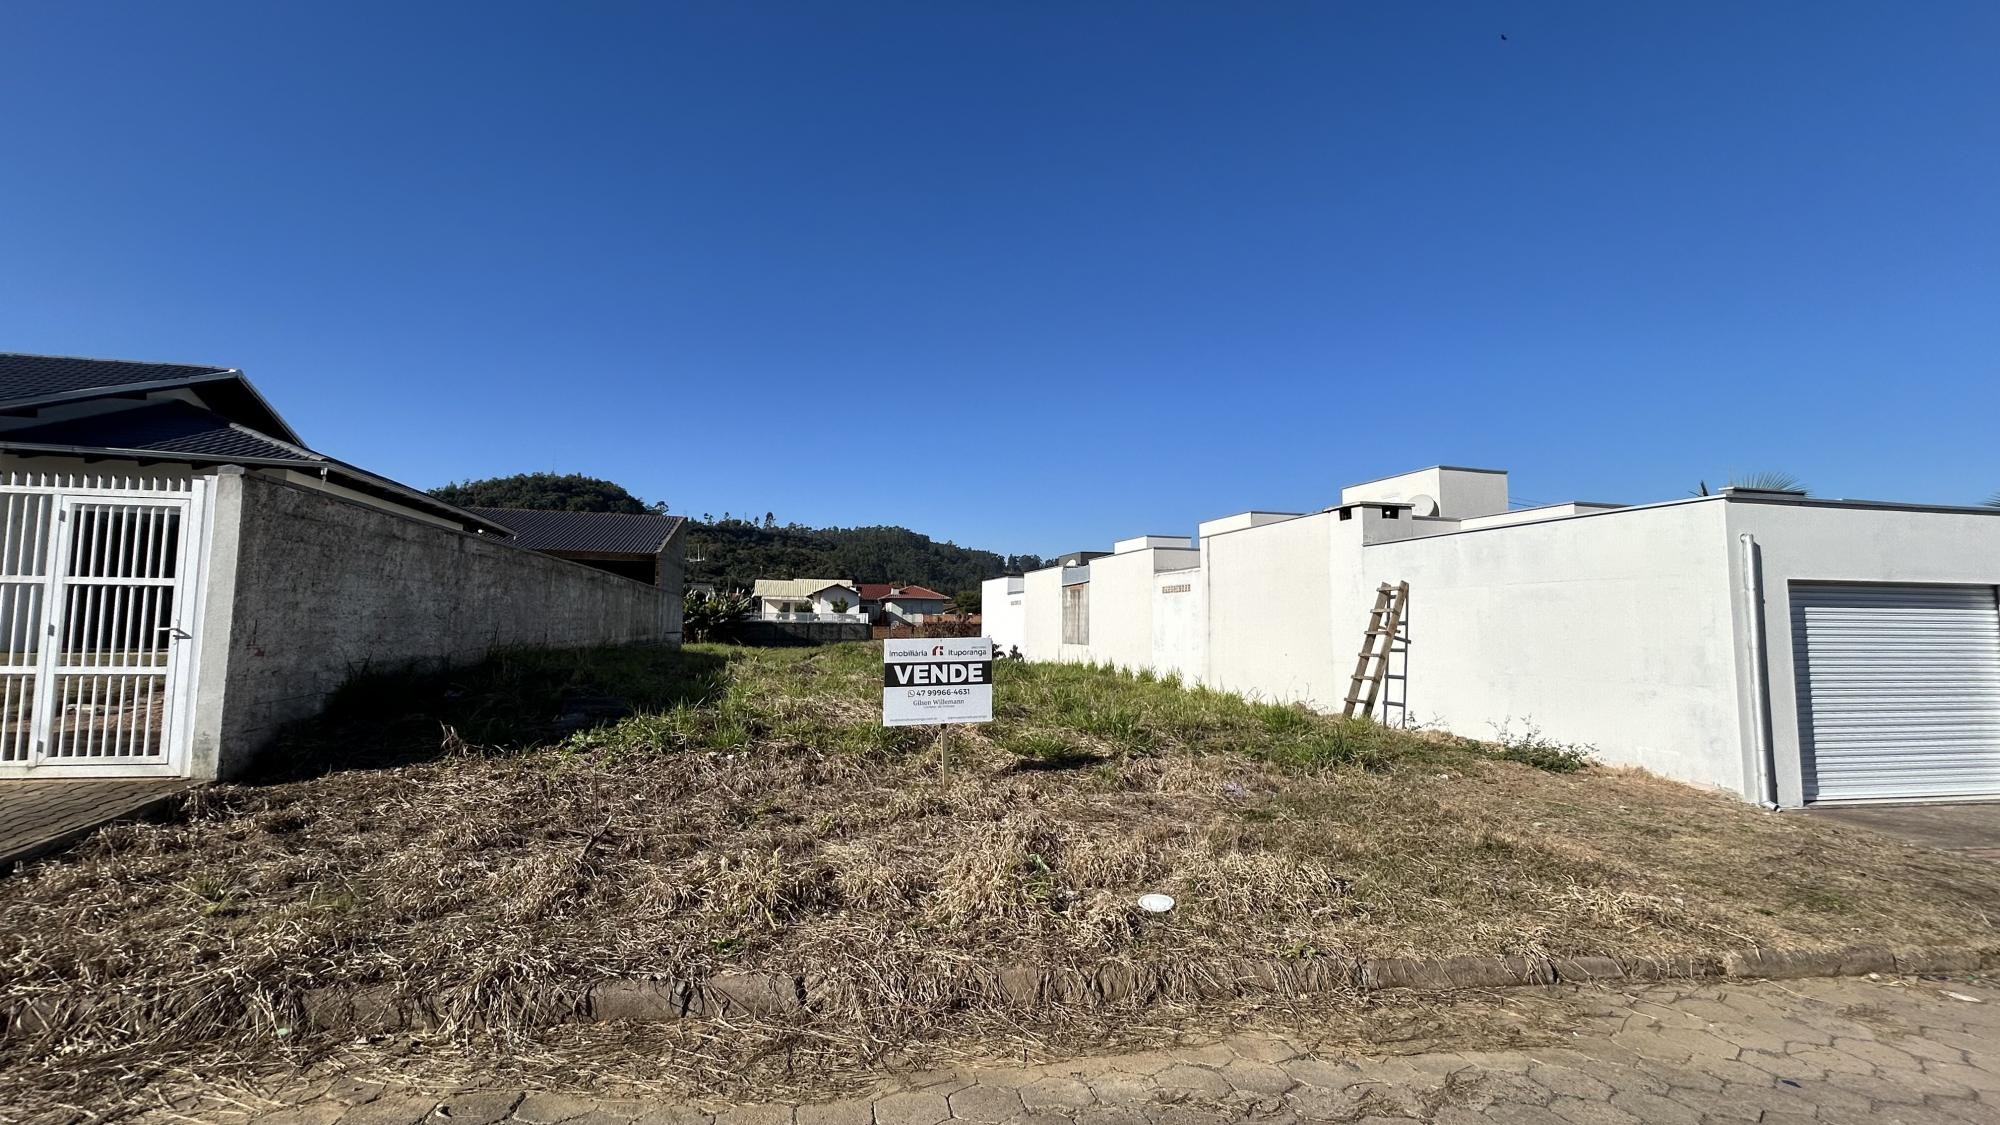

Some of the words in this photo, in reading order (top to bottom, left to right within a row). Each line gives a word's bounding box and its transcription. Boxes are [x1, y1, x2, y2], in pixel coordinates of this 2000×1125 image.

[948, 649, 987, 658] Ituporanga
[894, 663, 984, 685] VENDE
[916, 689, 926, 697] 47
[927, 688, 970, 697] 99966-4631
